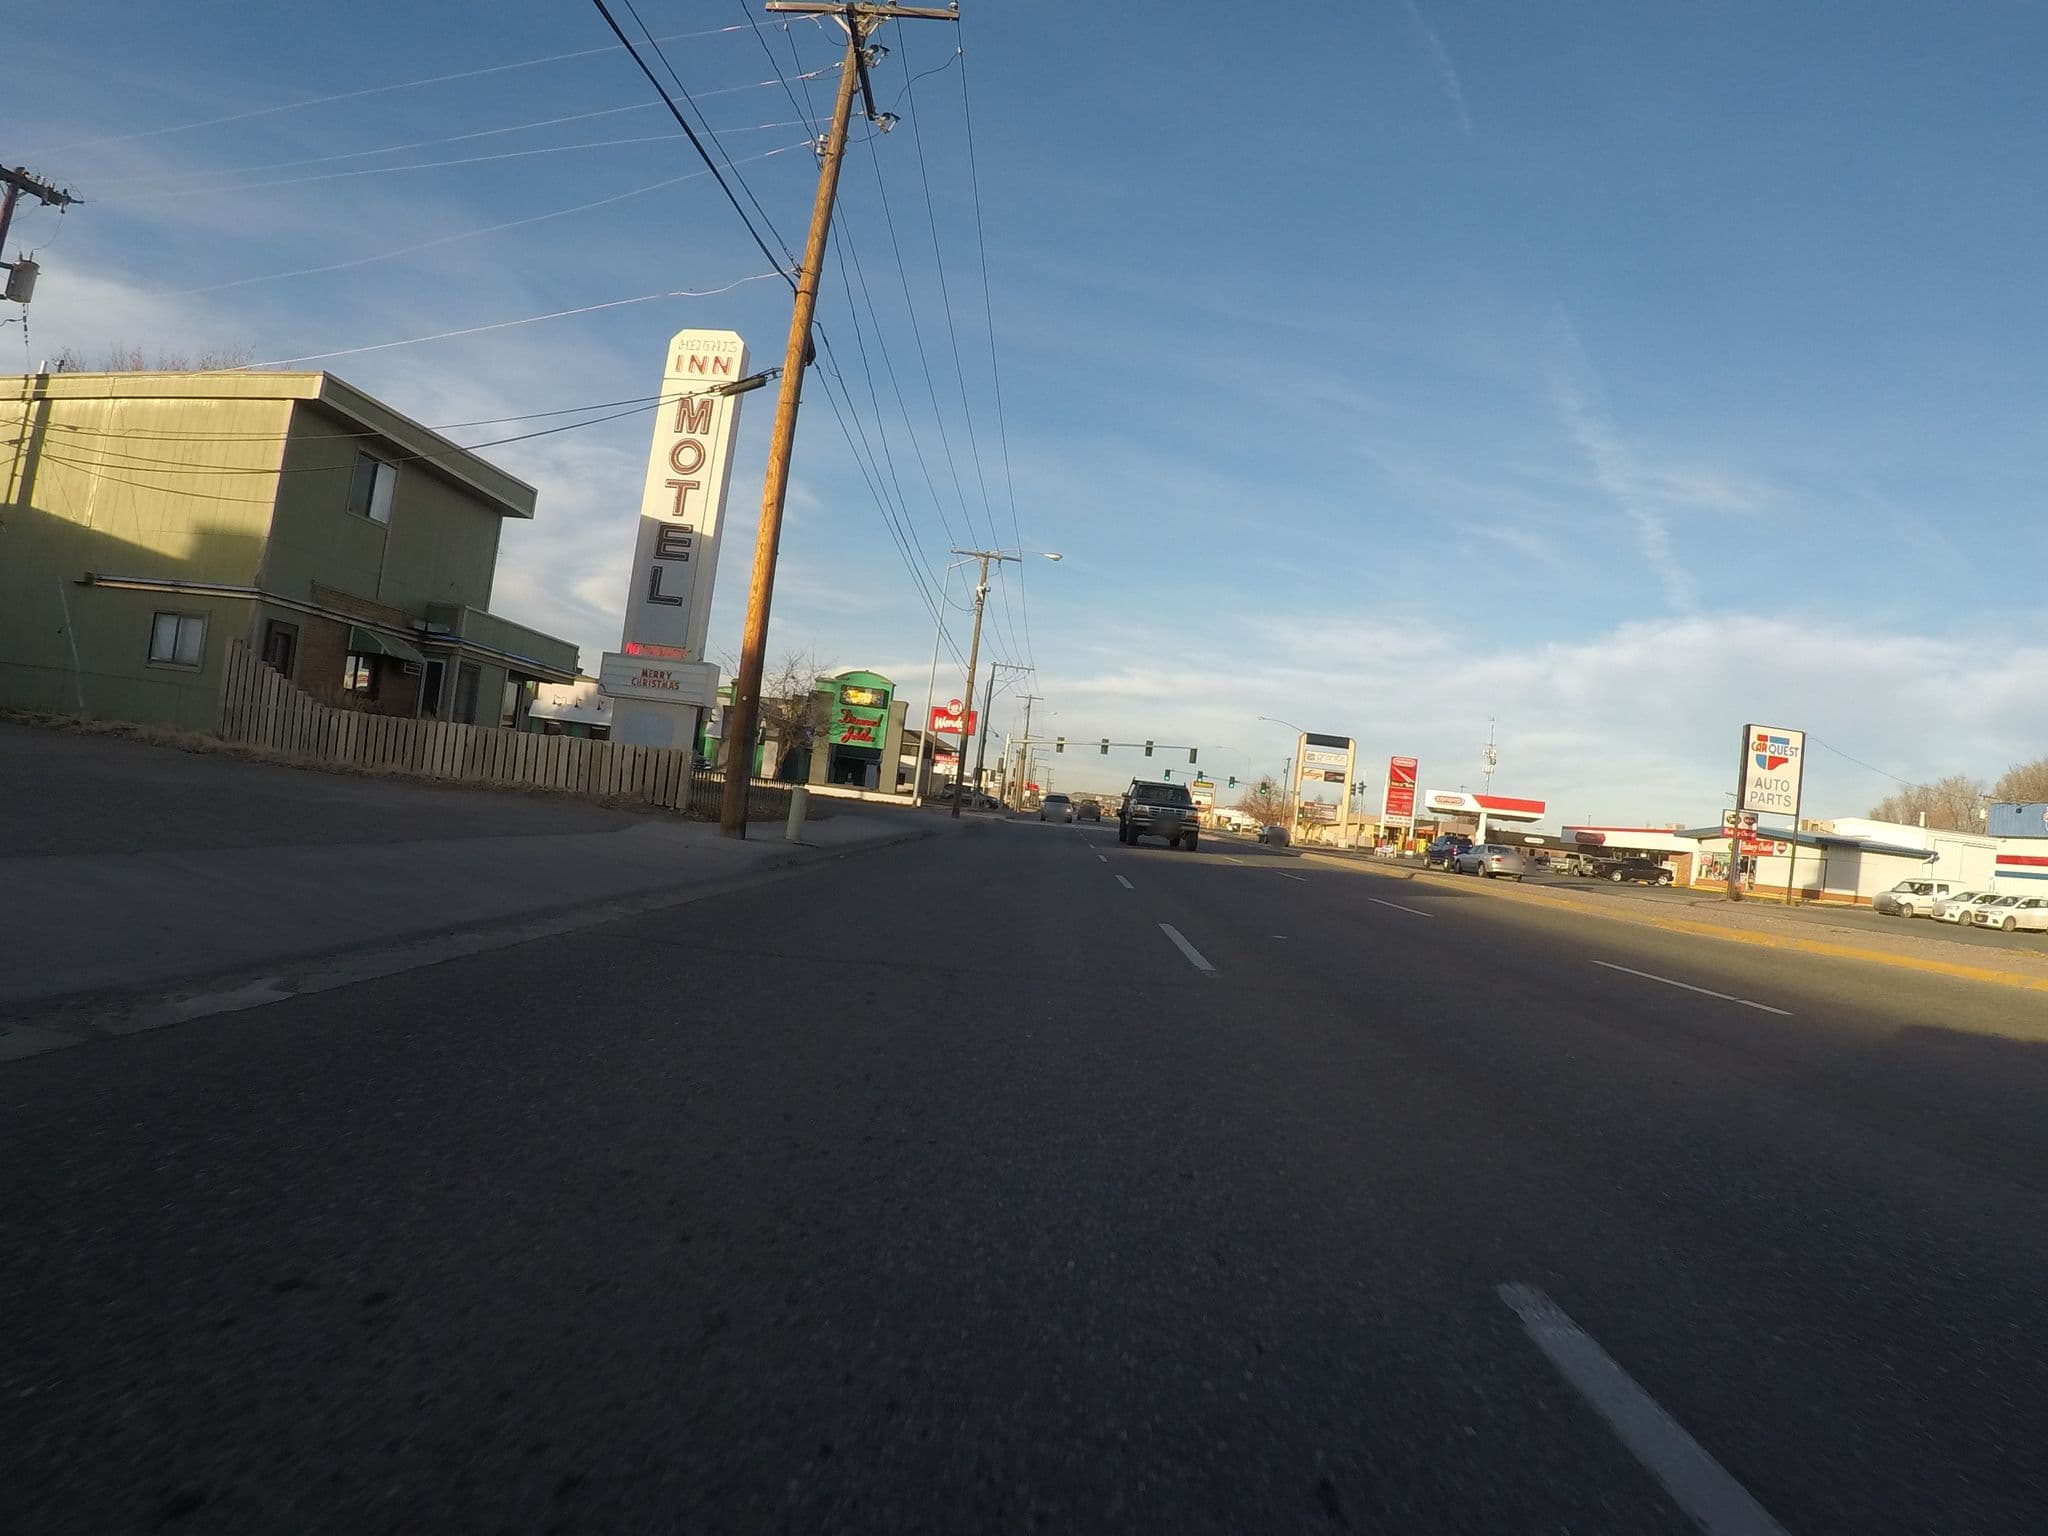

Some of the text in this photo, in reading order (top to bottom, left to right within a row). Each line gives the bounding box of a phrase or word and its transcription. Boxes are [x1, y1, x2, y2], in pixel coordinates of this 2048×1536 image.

[675, 354, 733, 376] INN
[647, 396, 714, 607] MOTEL
[640, 668, 673, 680] MERRY
[631, 676, 680, 690] CHRISTMAS
[934, 716, 964, 732] Wend
[935, 754, 960, 764] QUALIT
[1754, 777, 1790, 793] AUTO
[1750, 790, 1792, 808] PARTS
